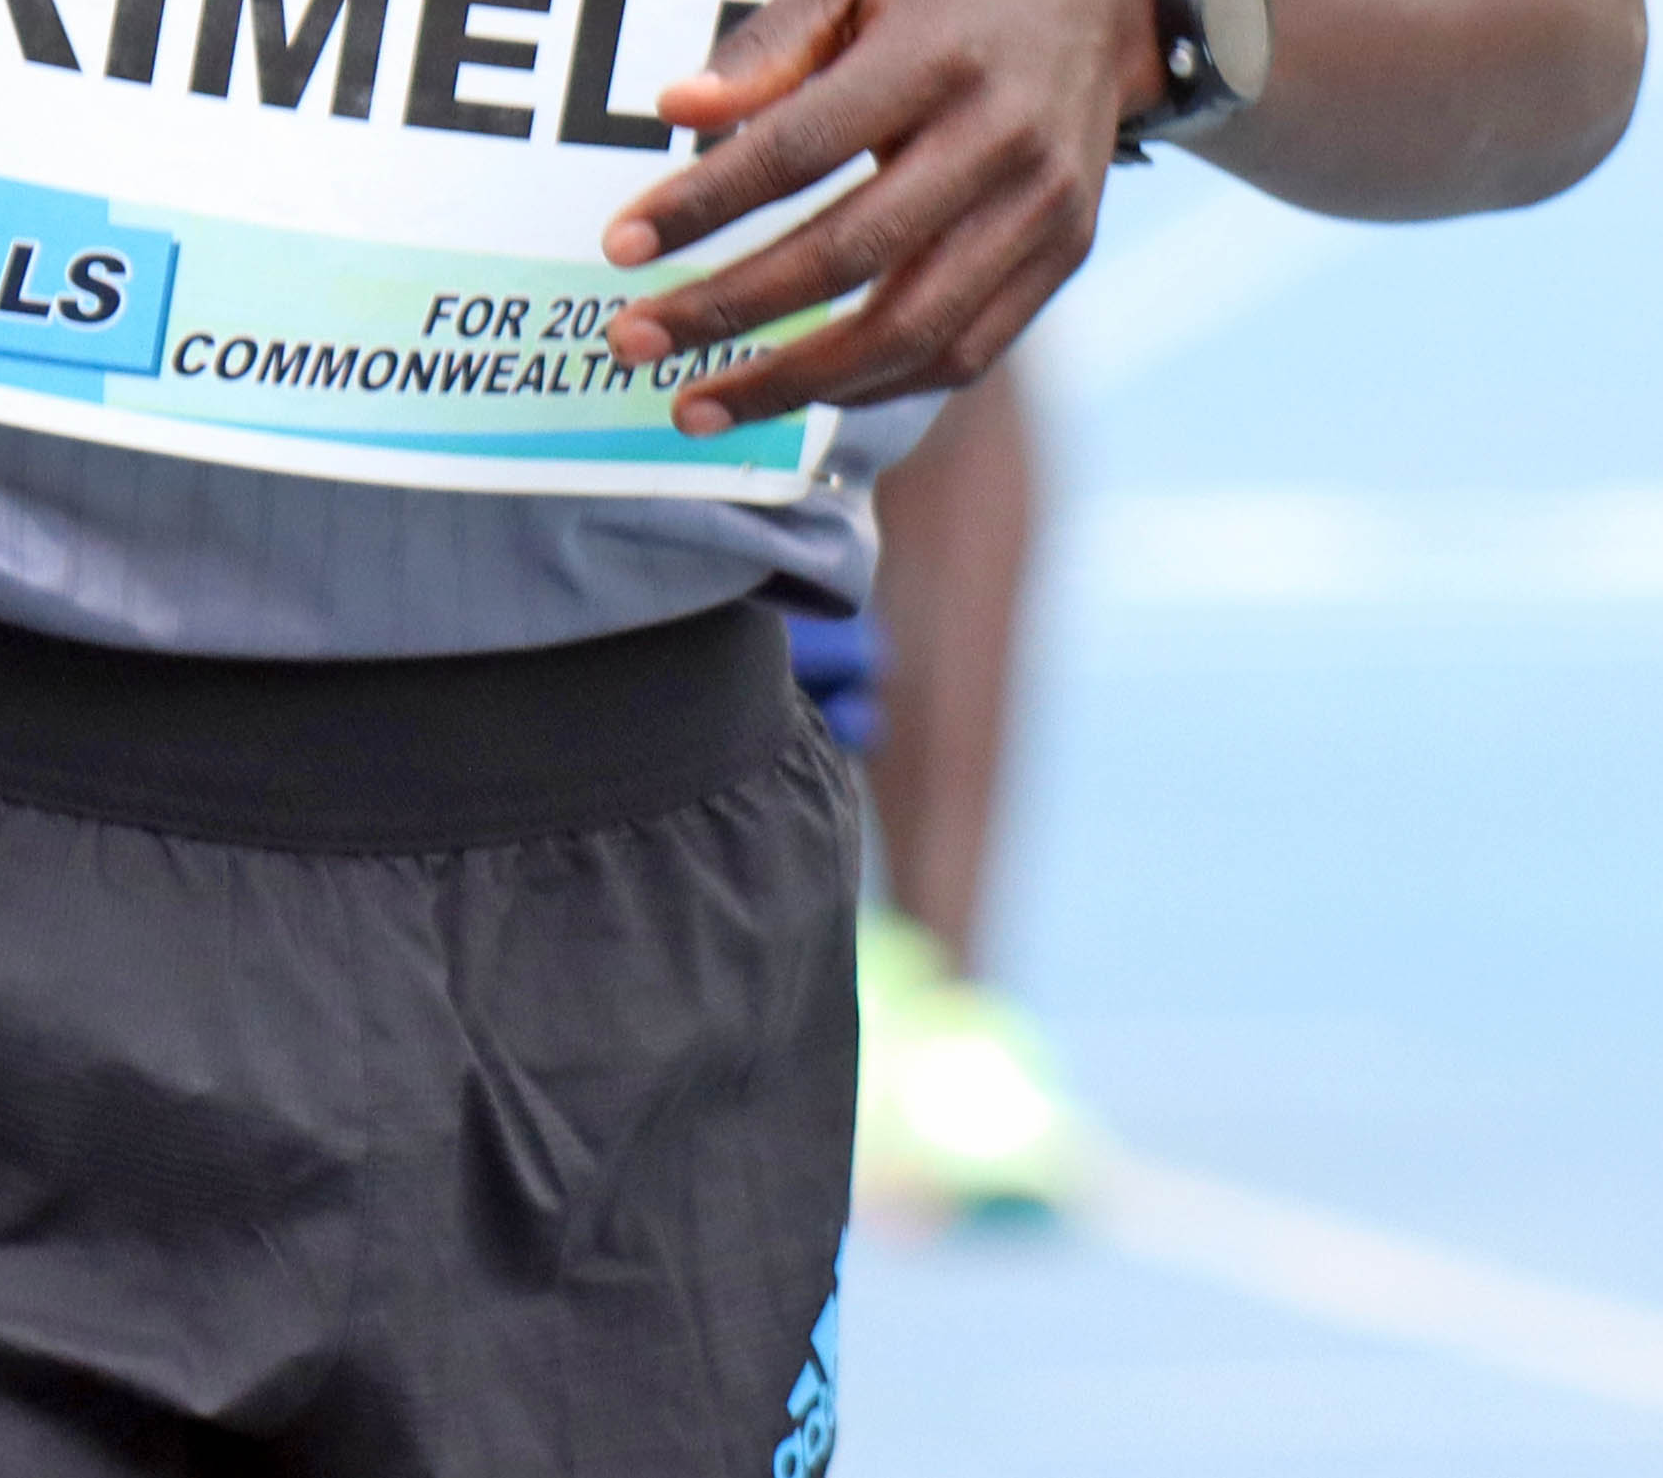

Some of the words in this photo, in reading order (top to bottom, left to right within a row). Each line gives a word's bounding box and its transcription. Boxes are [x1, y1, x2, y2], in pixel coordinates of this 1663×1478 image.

[421, 293, 529, 339] FOR
[540, 296, 629, 340] 202
[172, 331, 637, 397] COMMONWEALTH
